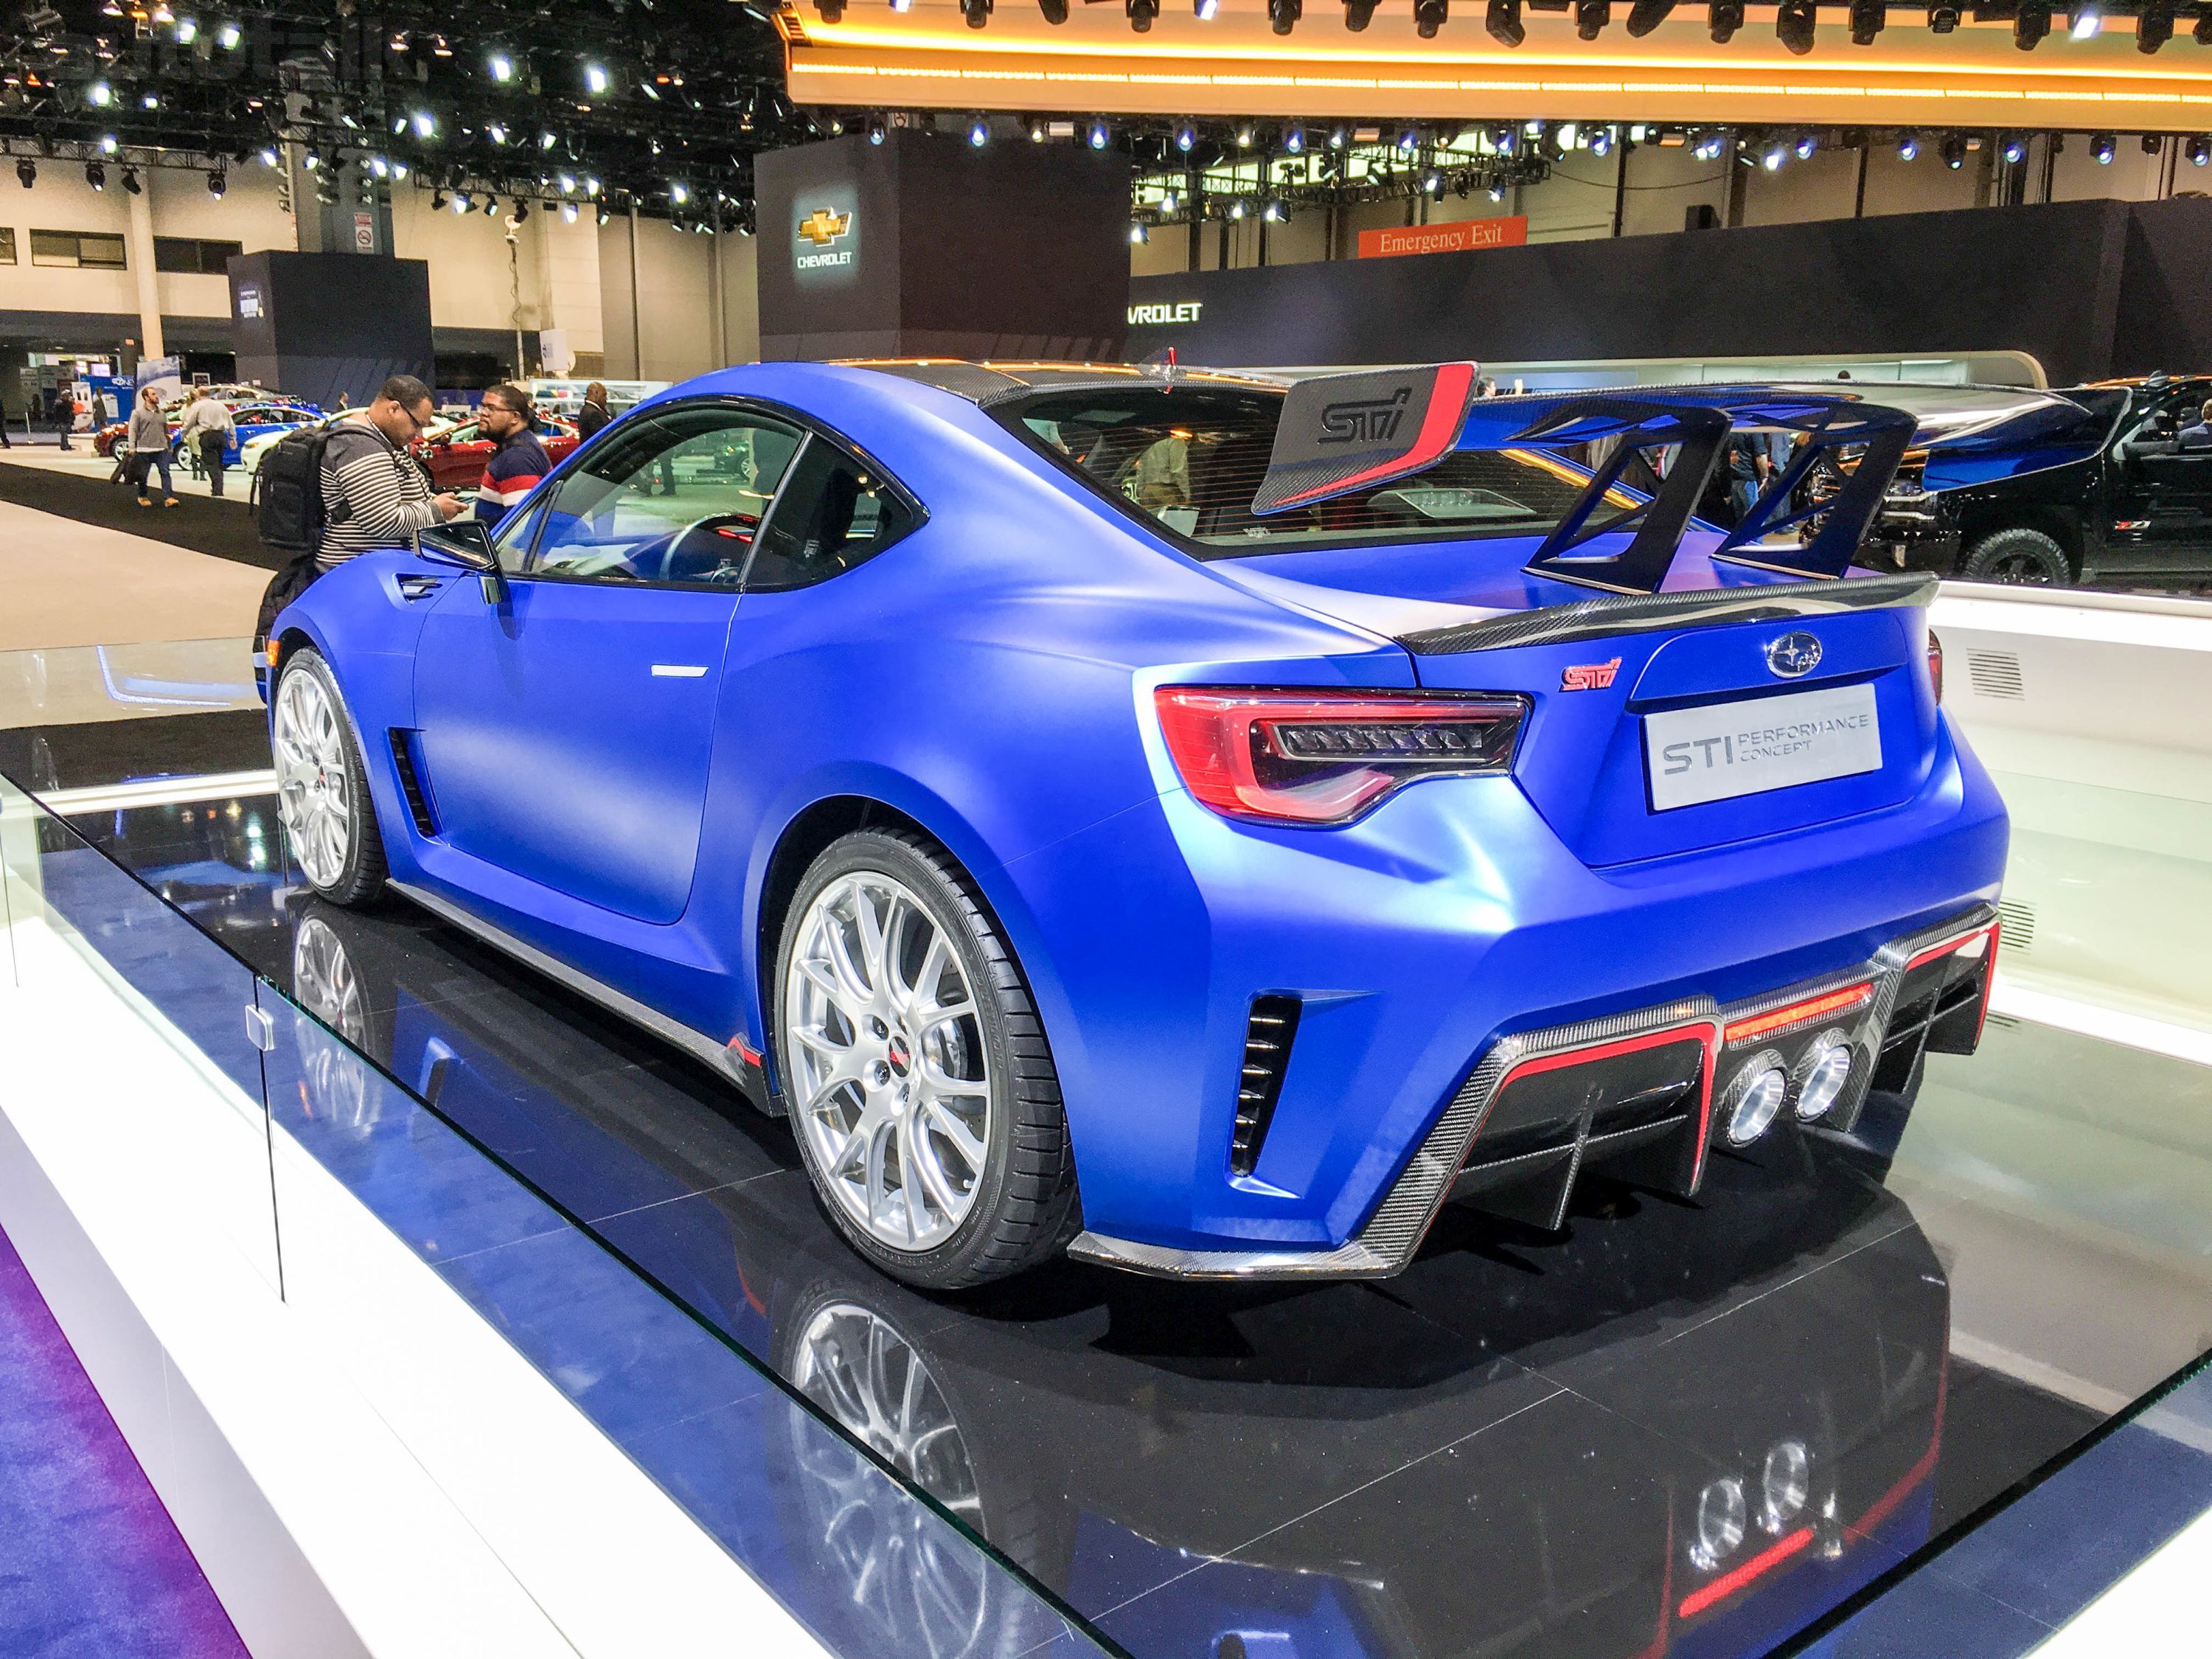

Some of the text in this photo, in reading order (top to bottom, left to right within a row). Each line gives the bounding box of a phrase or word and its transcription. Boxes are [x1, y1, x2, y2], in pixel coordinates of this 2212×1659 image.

[1380, 223, 1503, 254] Emergency Exit
[797, 251, 852, 269] CHEVROLET
[1737, 714, 1870, 747] PERFORMANCE
[1662, 735, 1733, 775] STI
[1739, 740, 1812, 762] CONCEPT
